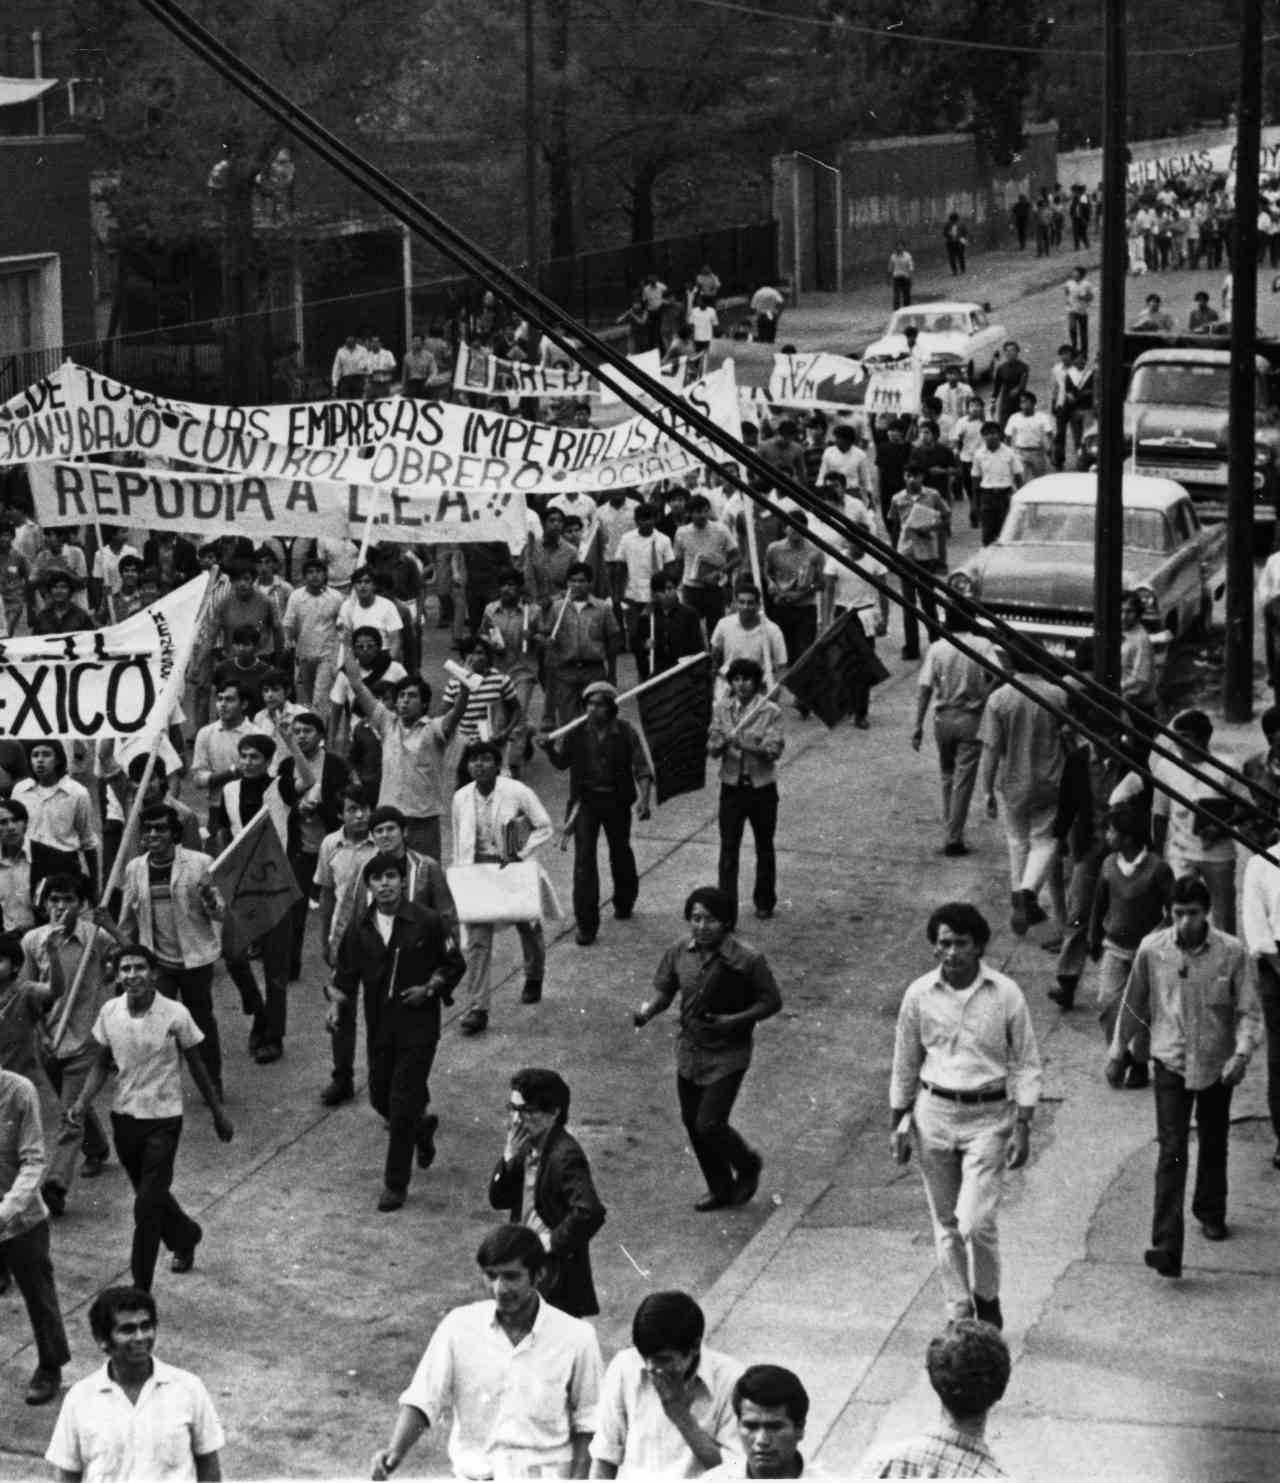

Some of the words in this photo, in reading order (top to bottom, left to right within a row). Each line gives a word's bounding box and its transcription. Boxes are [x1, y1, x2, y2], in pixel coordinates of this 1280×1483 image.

[24, 377, 66, 415] DE
[208, 406, 271, 441] LAS
[287, 398, 445, 449] EMPRESAS
[76, 404, 162, 453] BAJO
[177, 417, 348, 482] CONTROL
[370, 442, 545, 491] OBRERO
[53, 465, 276, 522] REPUDIA
[285, 480, 319, 512] A
